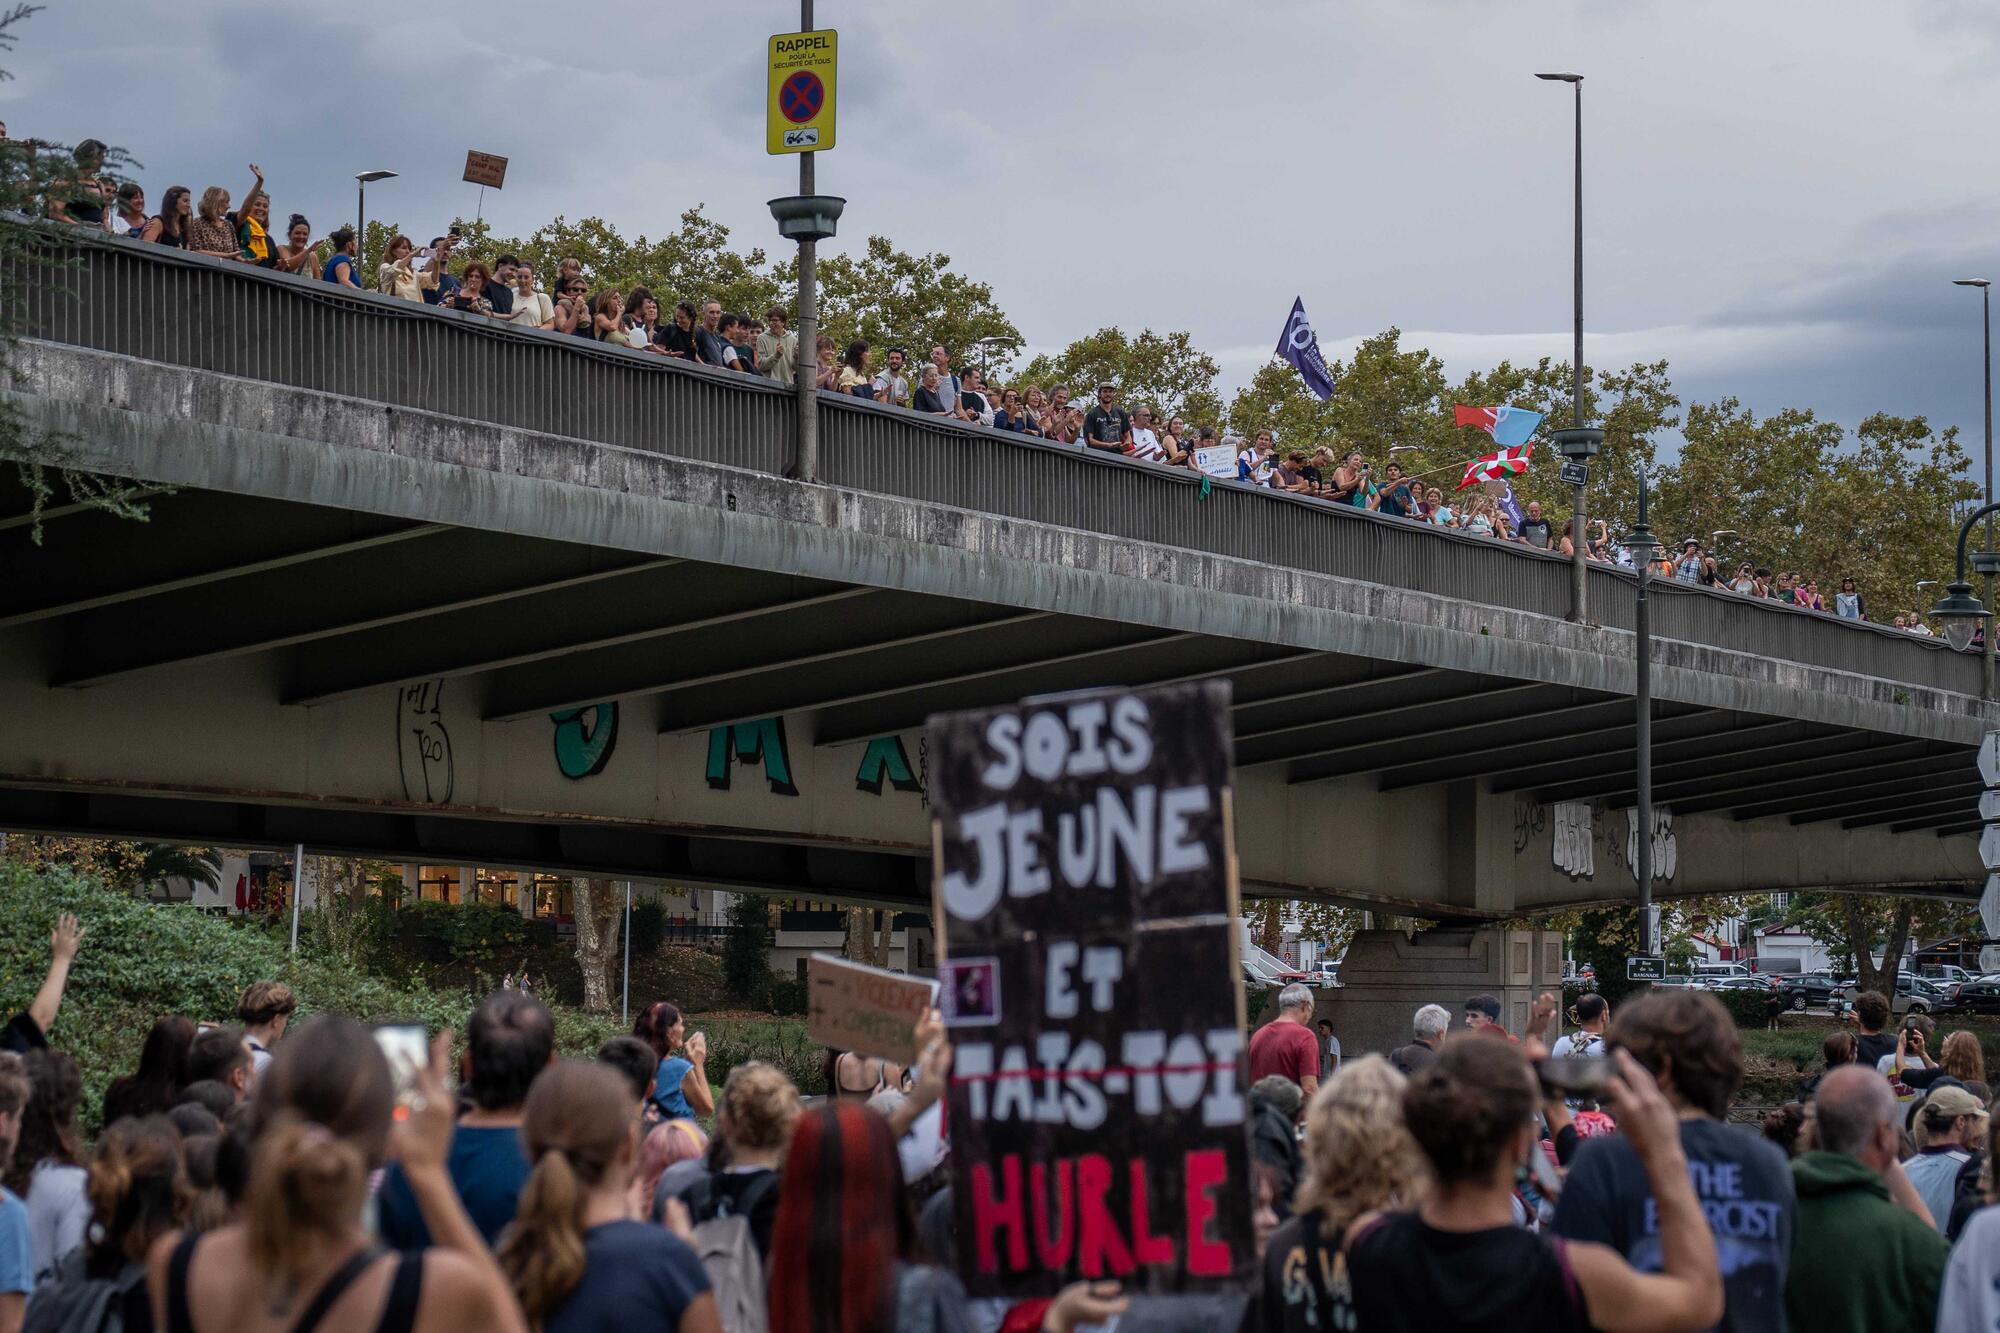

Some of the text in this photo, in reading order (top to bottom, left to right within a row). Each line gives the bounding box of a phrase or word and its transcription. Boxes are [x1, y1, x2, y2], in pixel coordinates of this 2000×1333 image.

[776, 36, 830, 53] RAPPEL
[1307, 348, 1328, 373] FRANCE
[1310, 344, 1317, 354] LA
[984, 698, 1152, 789] SOIS
[943, 785, 1209, 920] JEUNE
[1047, 942, 1122, 1017] ET
[955, 1030, 1244, 1130] TAIS-TOI
[972, 1151, 1231, 1276] HURLE
